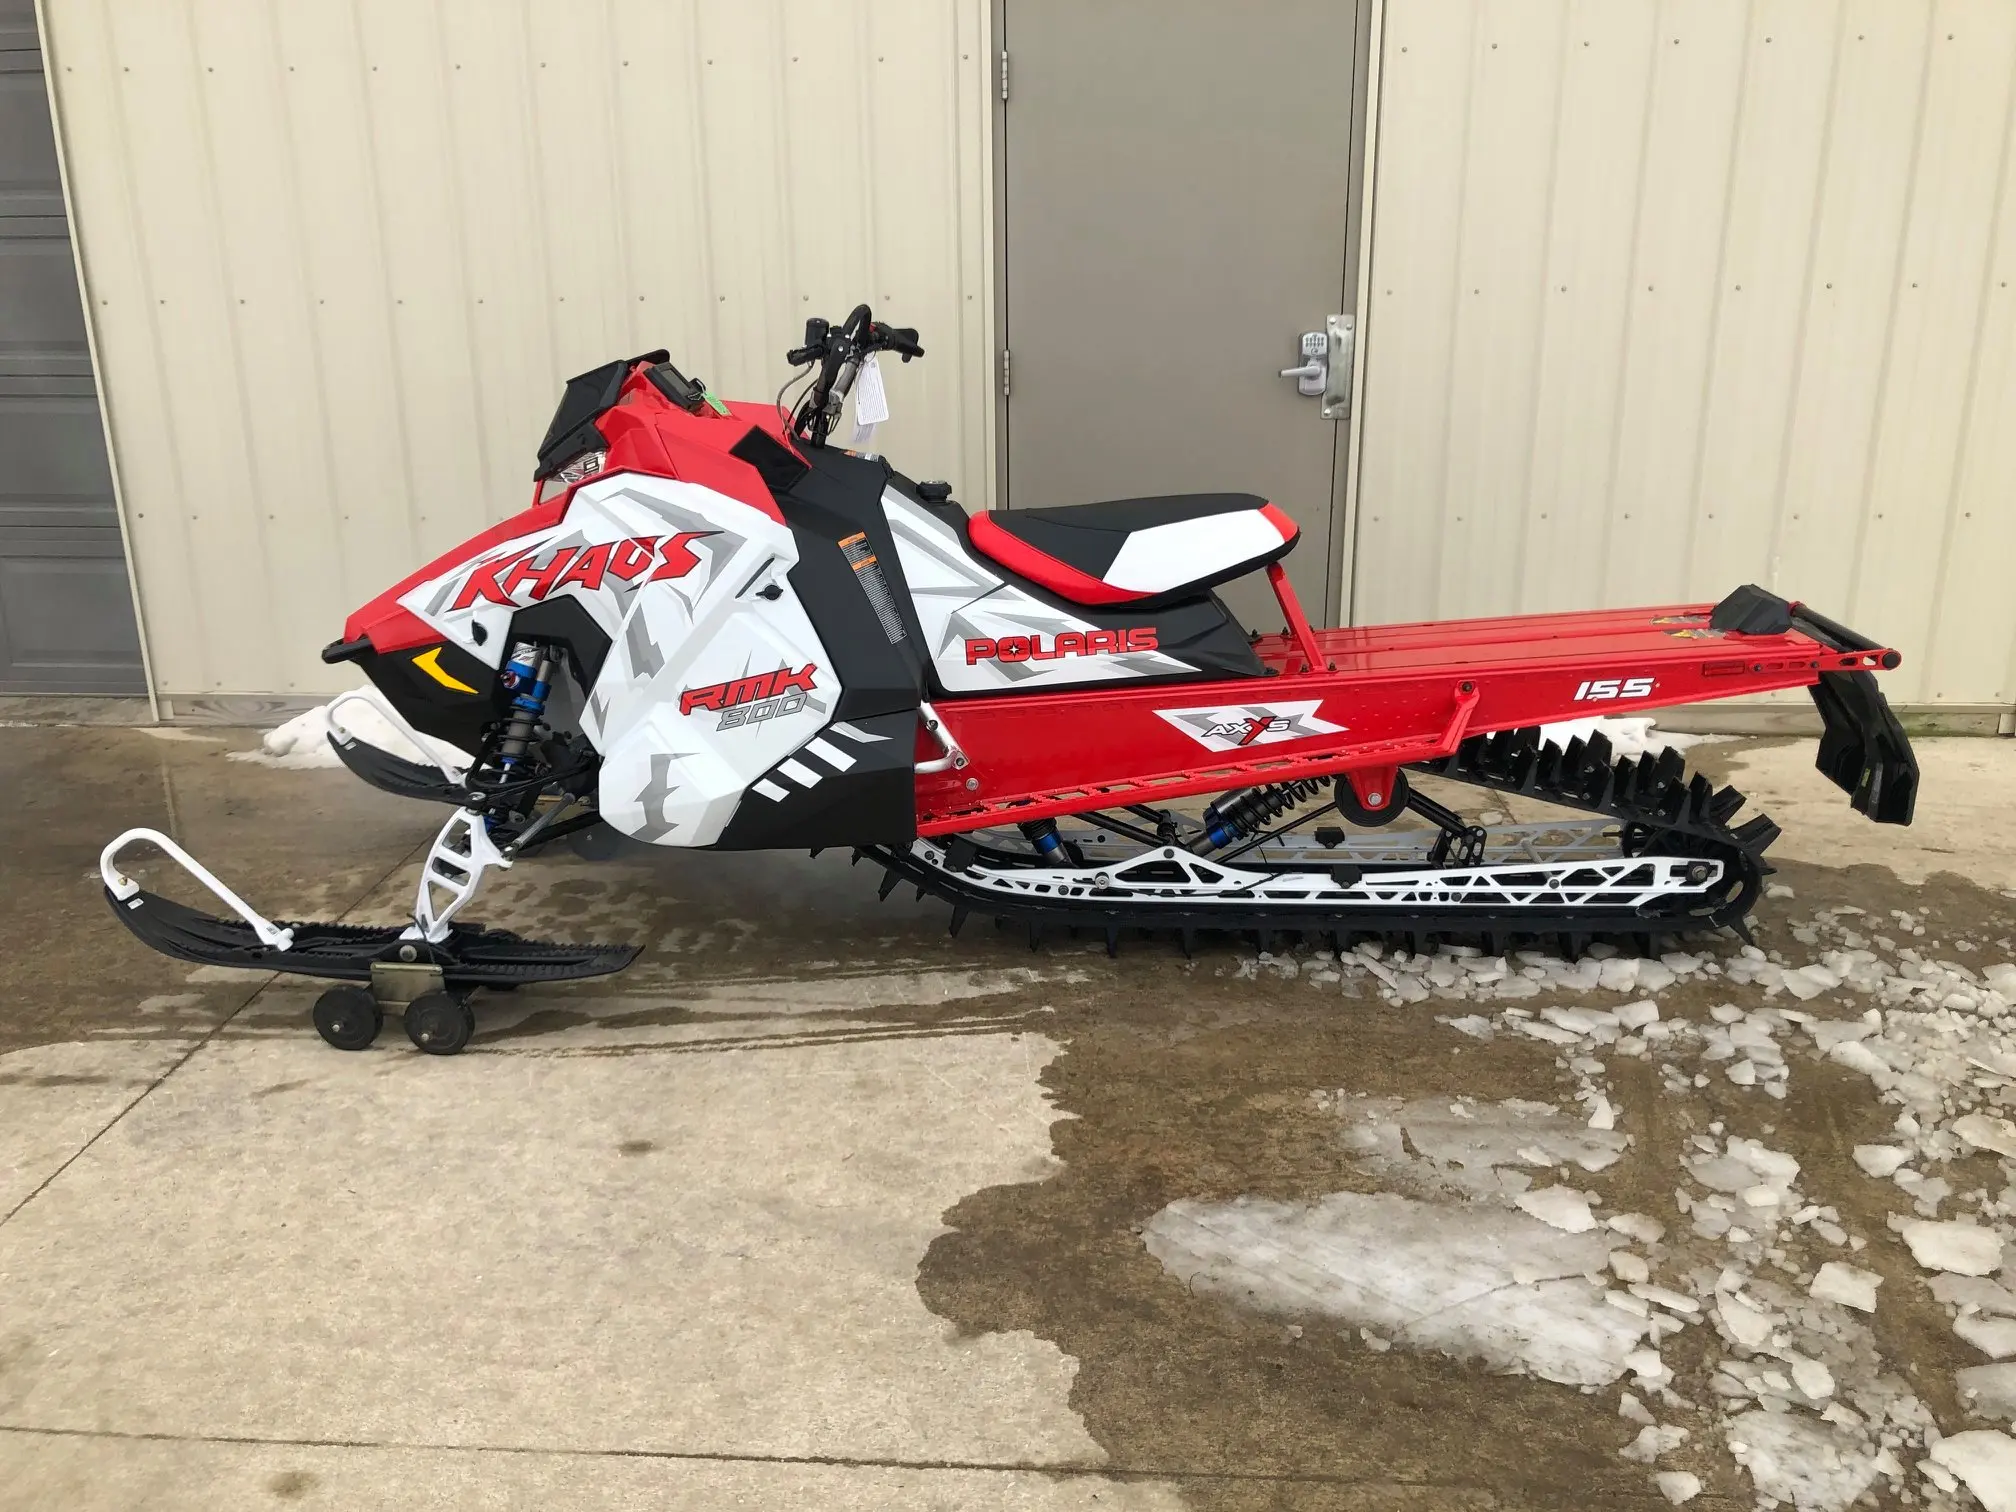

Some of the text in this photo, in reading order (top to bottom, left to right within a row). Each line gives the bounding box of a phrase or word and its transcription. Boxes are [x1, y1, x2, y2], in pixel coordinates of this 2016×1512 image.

[965, 627, 1159, 666] POLARIS
[679, 663, 818, 716] RMK
[1573, 677, 1656, 701] 155
[716, 692, 808, 732] 800
[1201, 715, 1291, 746] AXYS
